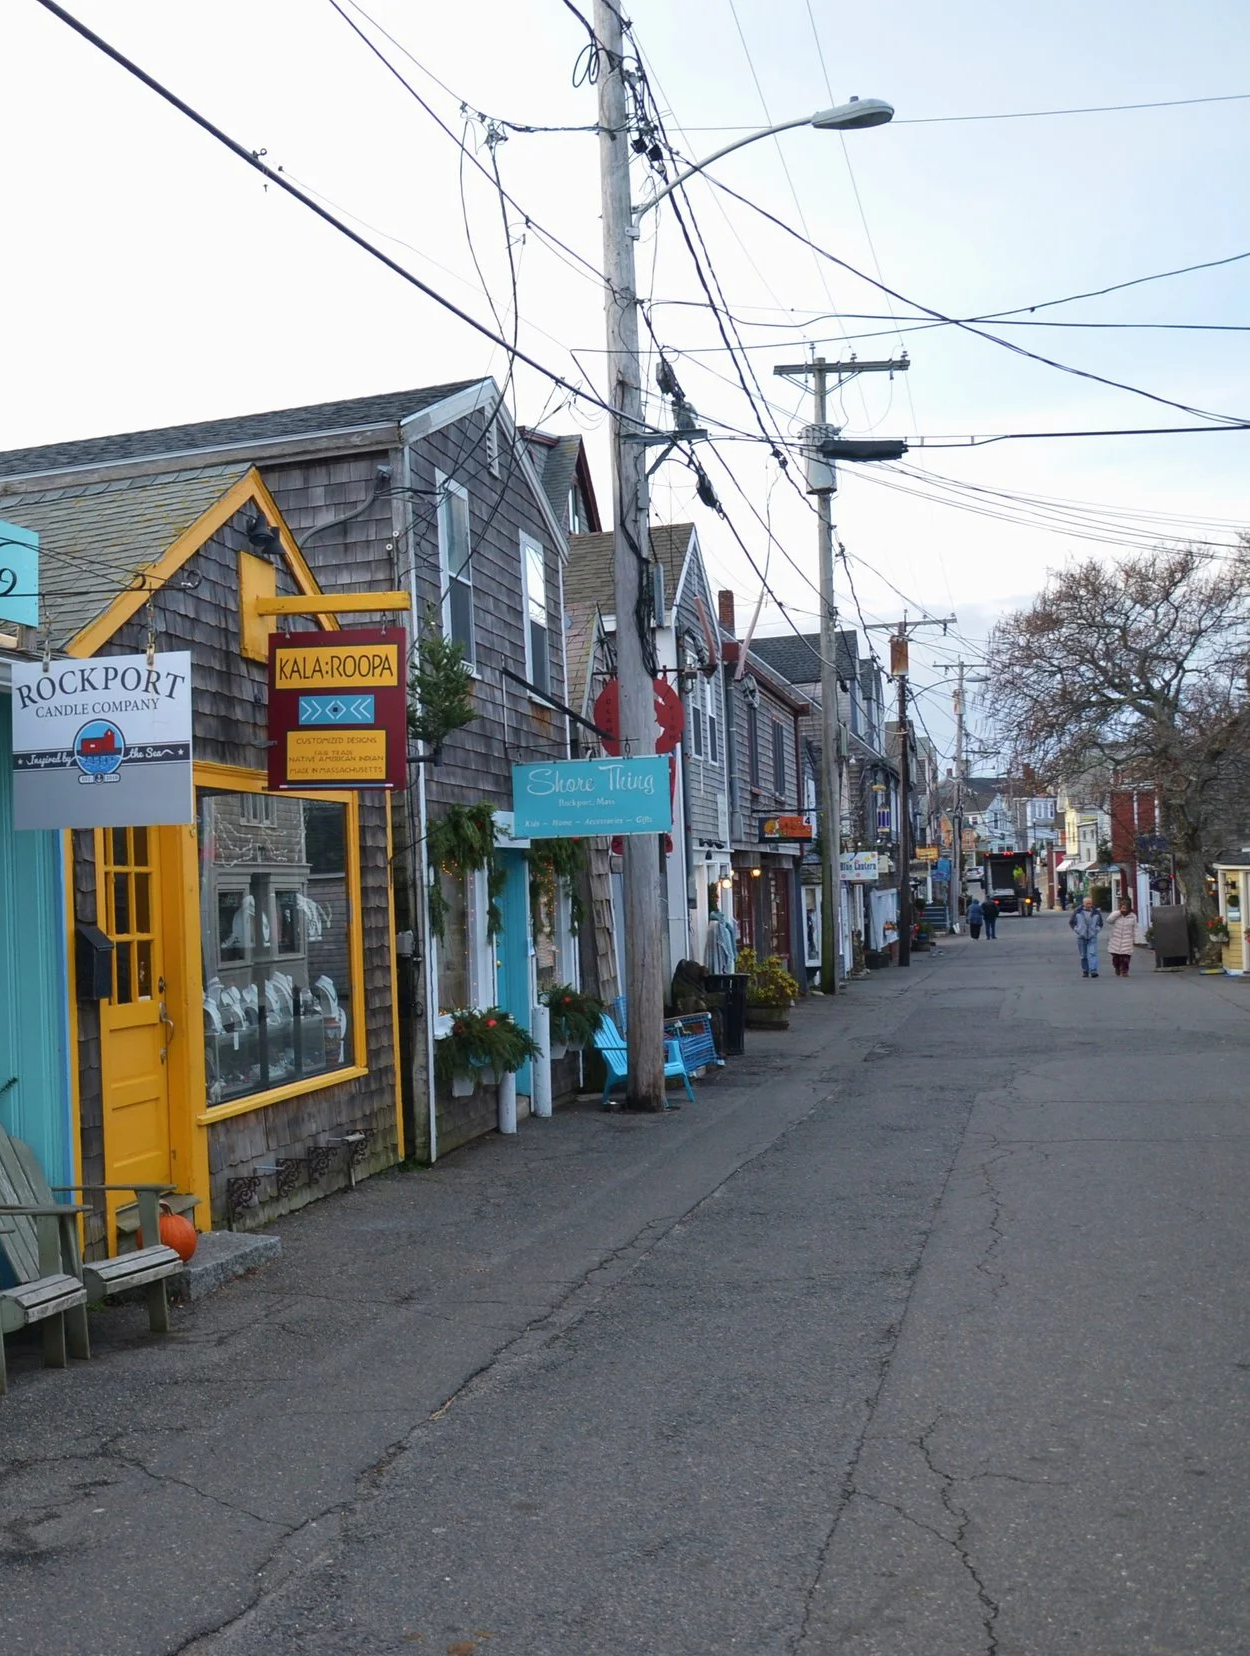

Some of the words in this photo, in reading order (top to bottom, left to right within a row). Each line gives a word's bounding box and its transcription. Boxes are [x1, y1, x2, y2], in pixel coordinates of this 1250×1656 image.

[15, 666, 186, 710] ROCKPORT
[35, 703, 89, 718] CANDLE
[92, 697, 160, 714] COMPANY
[347, 736, 377, 744] DESIGNS
[128, 748, 144, 759] the
[145, 746, 163, 758] Sea
[25, 753, 61, 767] Inspired
[61, 752, 73, 767] by
[527, 768, 595, 796] Shore
[598, 764, 655, 795] Thing
[596, 798, 616, 806] Mass
[525, 820, 540, 828] Kids
[552, 819, 573, 827] Home
[585, 817, 624, 826] Accessories
[635, 815, 653, 825] Gifts
[840, 862, 853, 871] Blue
